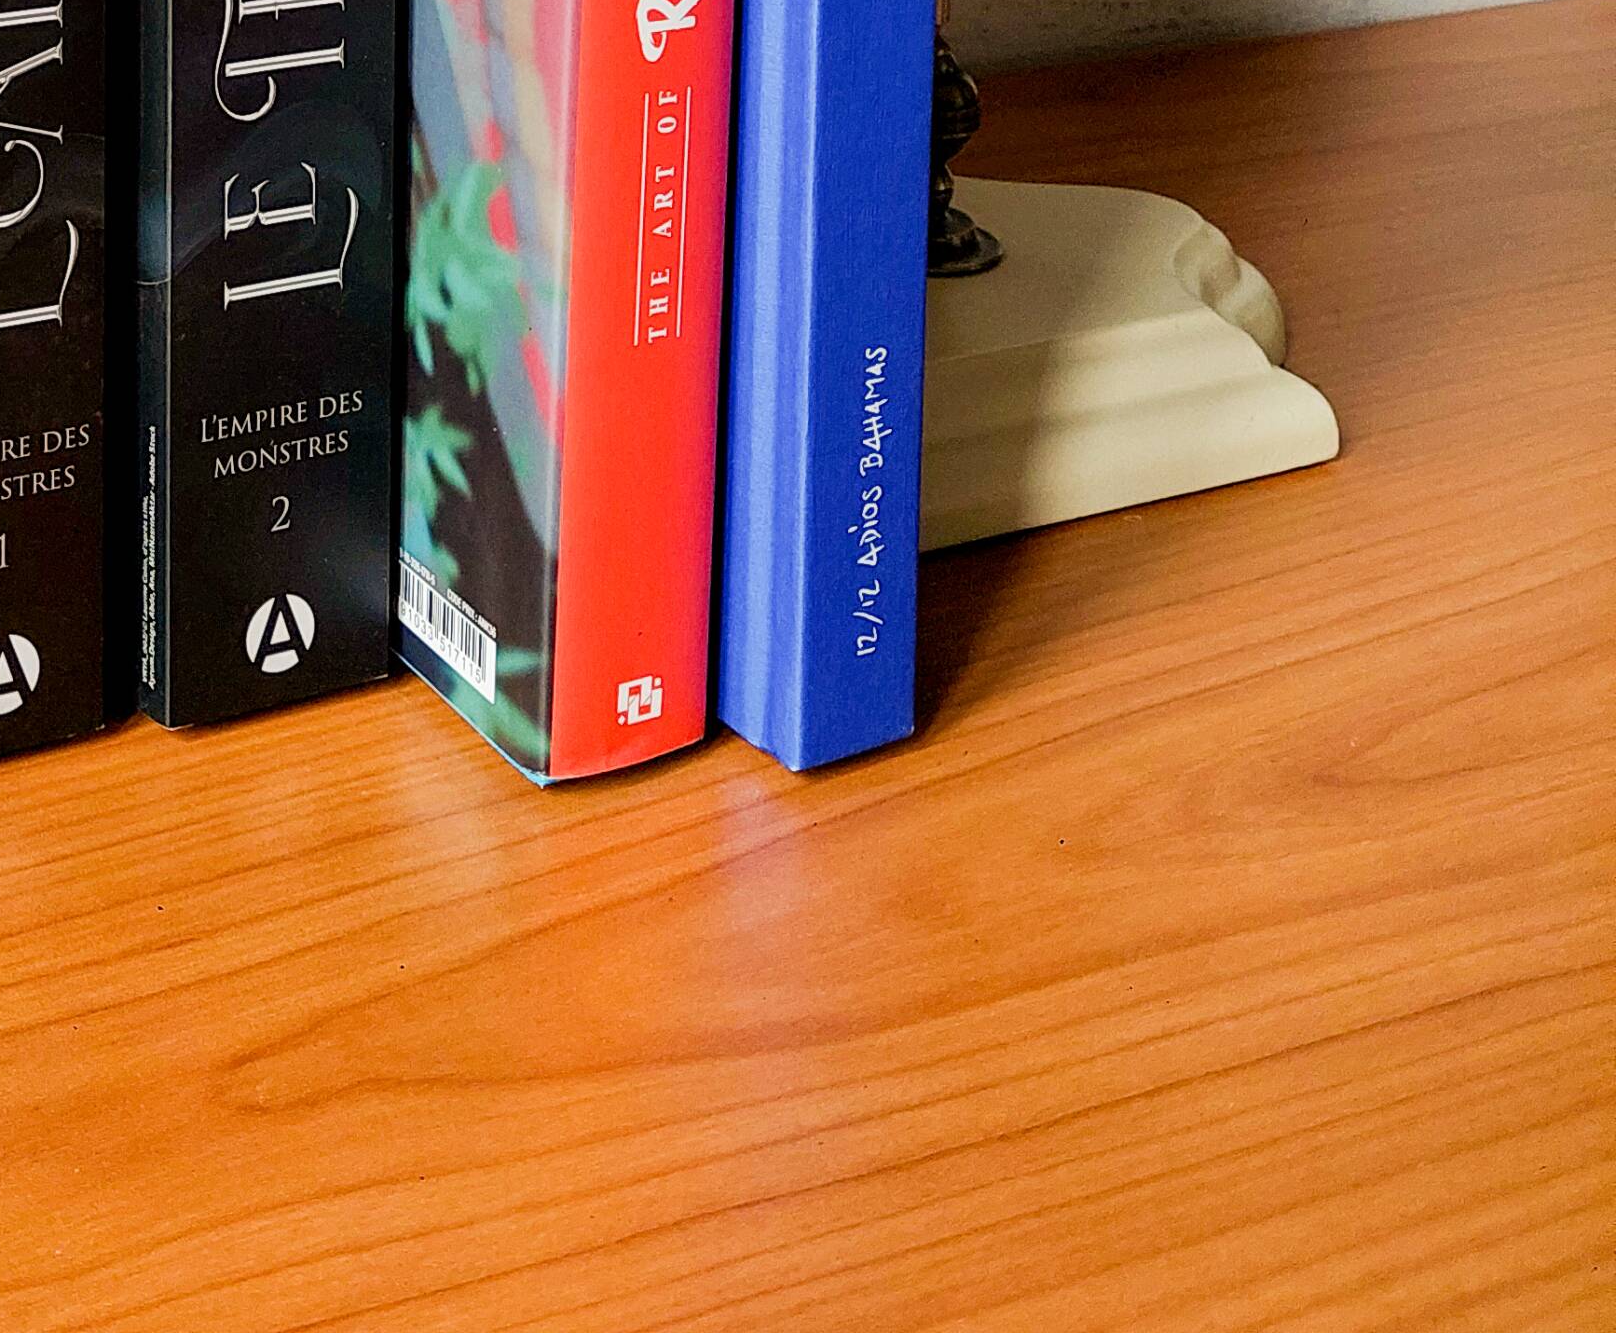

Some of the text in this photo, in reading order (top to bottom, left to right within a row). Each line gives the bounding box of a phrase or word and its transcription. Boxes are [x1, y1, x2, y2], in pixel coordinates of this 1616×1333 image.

[224, 161, 358, 311] LE
[648, 89, 679, 343] THE ART OF
[43, 423, 90, 454] DES
[201, 390, 363, 443] L'EMPIRE DES
[859, 346, 893, 477] BAHAMAS
[214, 430, 349, 478] MONSTRES
[271, 495, 291, 532] 2
[853, 580, 884, 656] 12/12
